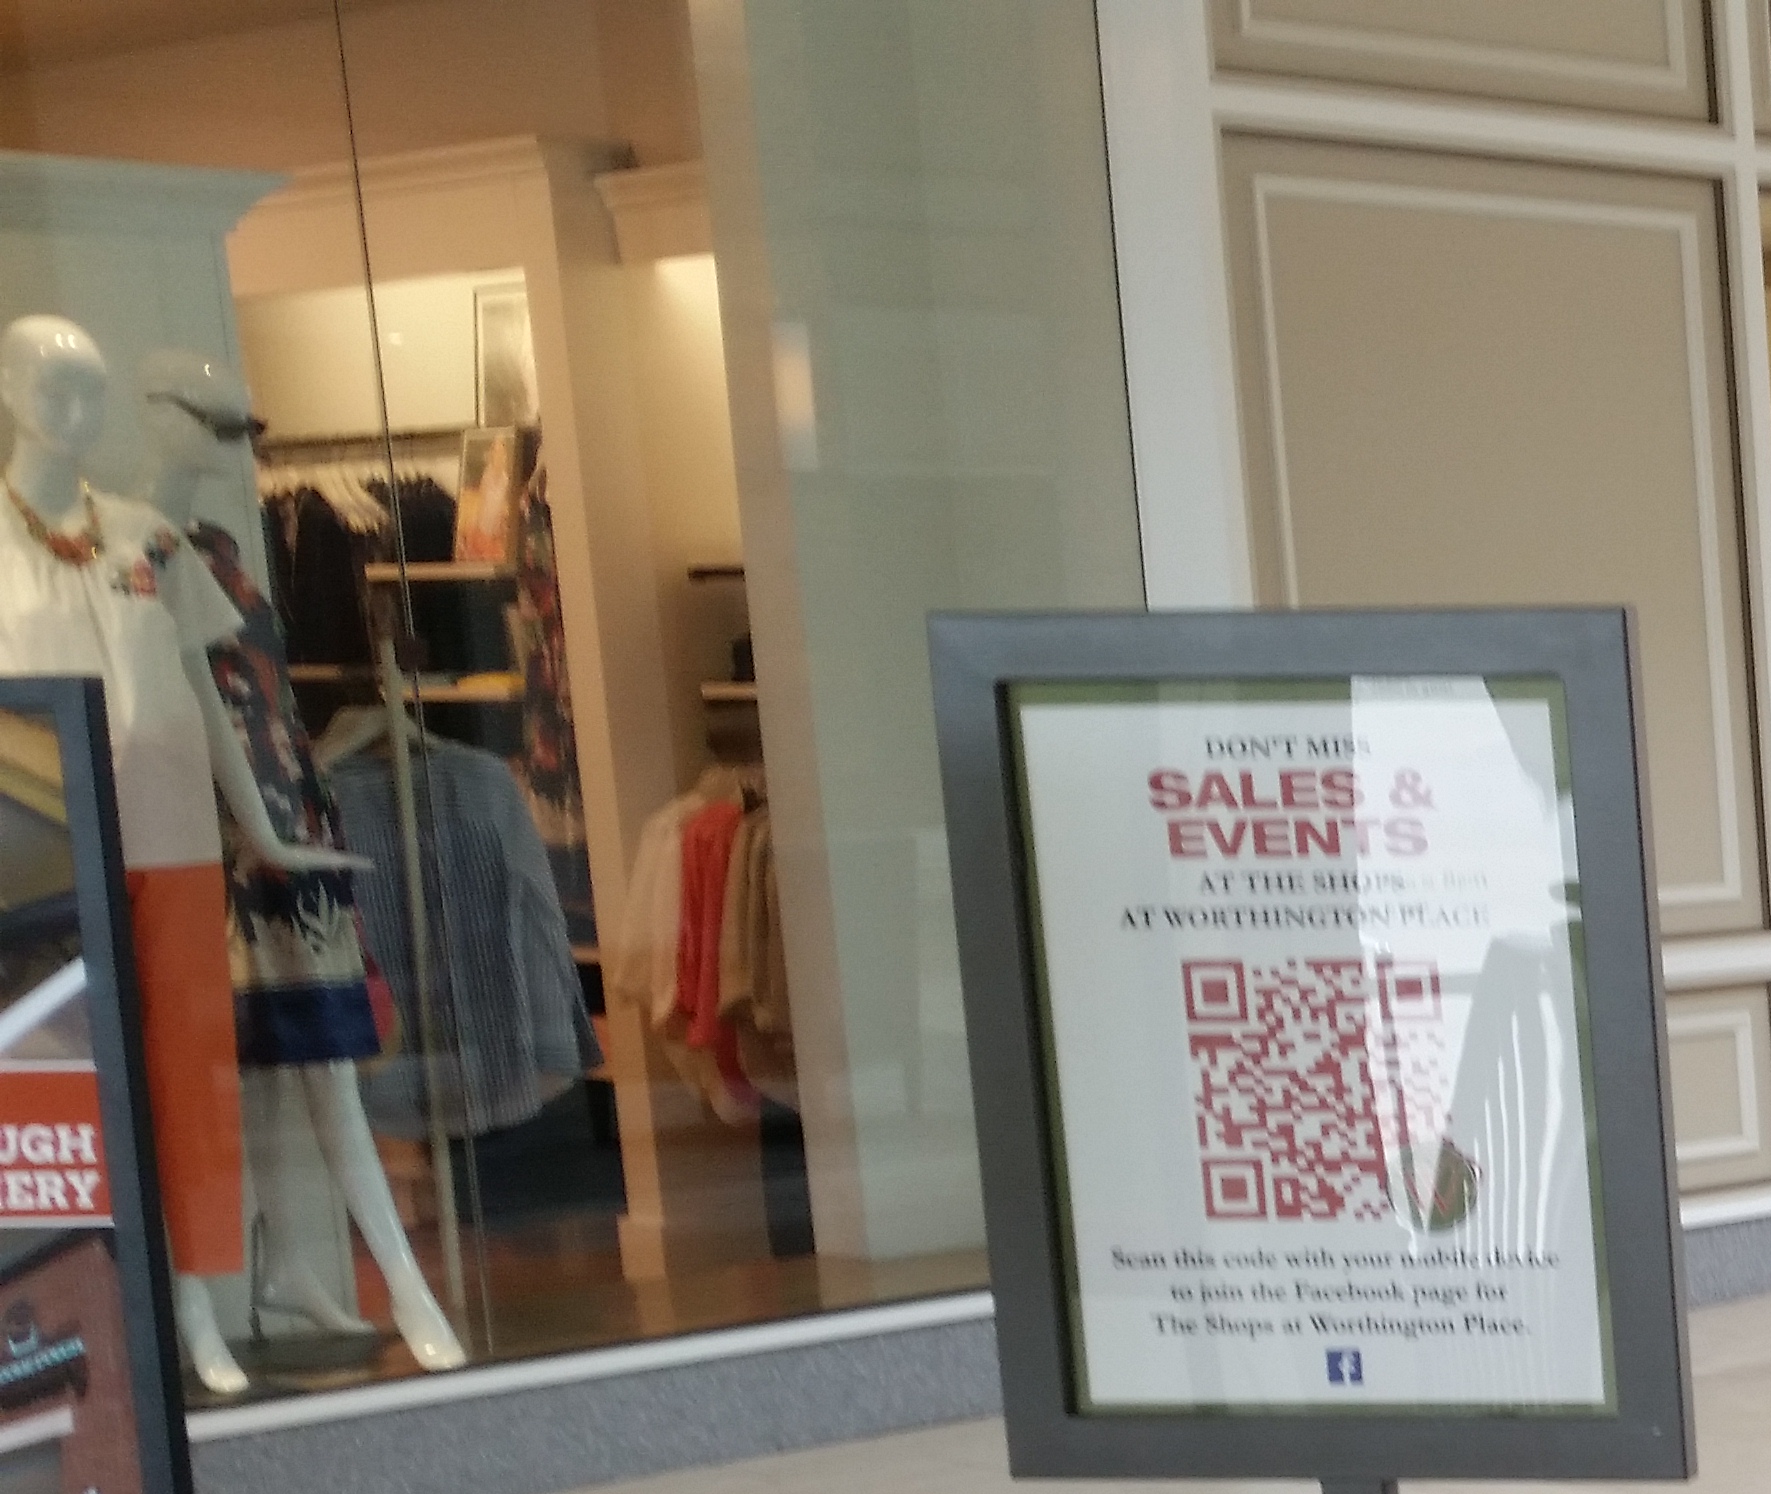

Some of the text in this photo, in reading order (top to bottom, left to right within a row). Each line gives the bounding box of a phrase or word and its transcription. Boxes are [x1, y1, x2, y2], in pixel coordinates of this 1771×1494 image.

[1205, 735, 1298, 759] DON'T
[1147, 768, 1437, 812] SALES &
[1166, 817, 1430, 860] EVENTS
[1200, 869, 1236, 894] AT
[1239, 869, 1305, 894] THE
[1312, 869, 1405, 895] SHOPS
[1120, 903, 1491, 930] AT WORTHINGTON PLACE
[0, 1169, 100, 1212] ERY
[1109, 1245, 1561, 1277] Scan this code with your mobile device
[1169, 1278, 1510, 1309] to join the Facebook page for
[1151, 1312, 1200, 1338] The
[1204, 1312, 1275, 1342] Shops
[1280, 1316, 1304, 1337] at
[1308, 1311, 1458, 1342] Worthington
